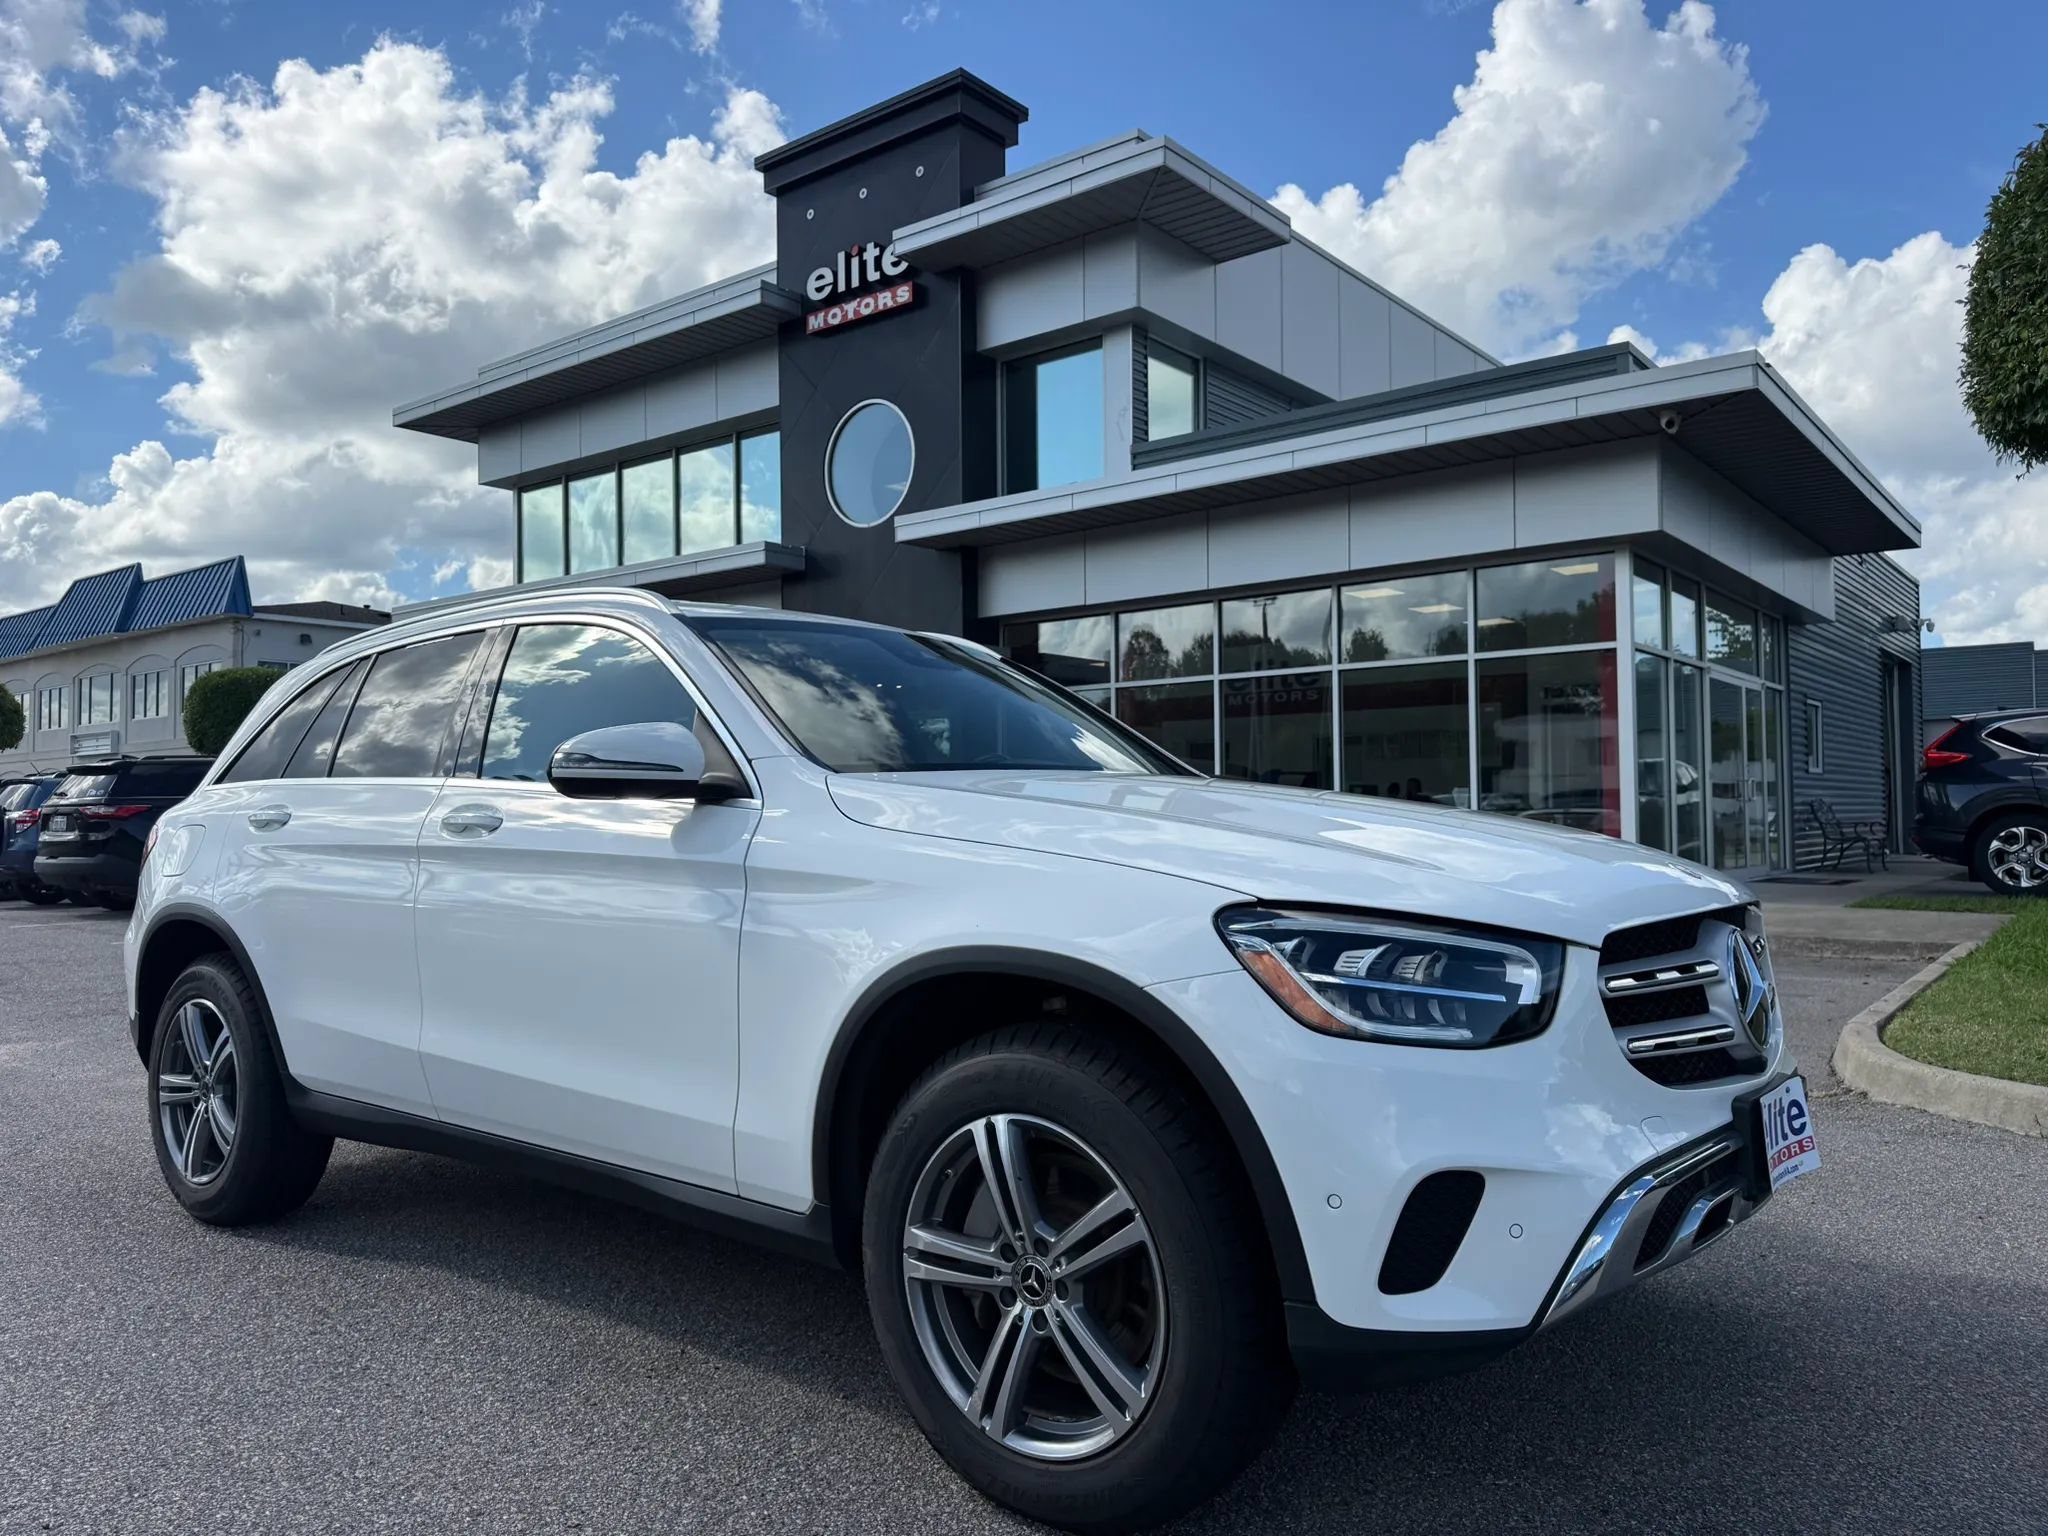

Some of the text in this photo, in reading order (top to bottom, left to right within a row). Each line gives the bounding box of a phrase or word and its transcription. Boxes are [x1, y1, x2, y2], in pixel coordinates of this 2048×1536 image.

[806, 241, 909, 301] elite
[808, 286, 910, 330] MOTORS
[1229, 690, 1320, 705] MOTORS
[1763, 1097, 1807, 1151] lite
